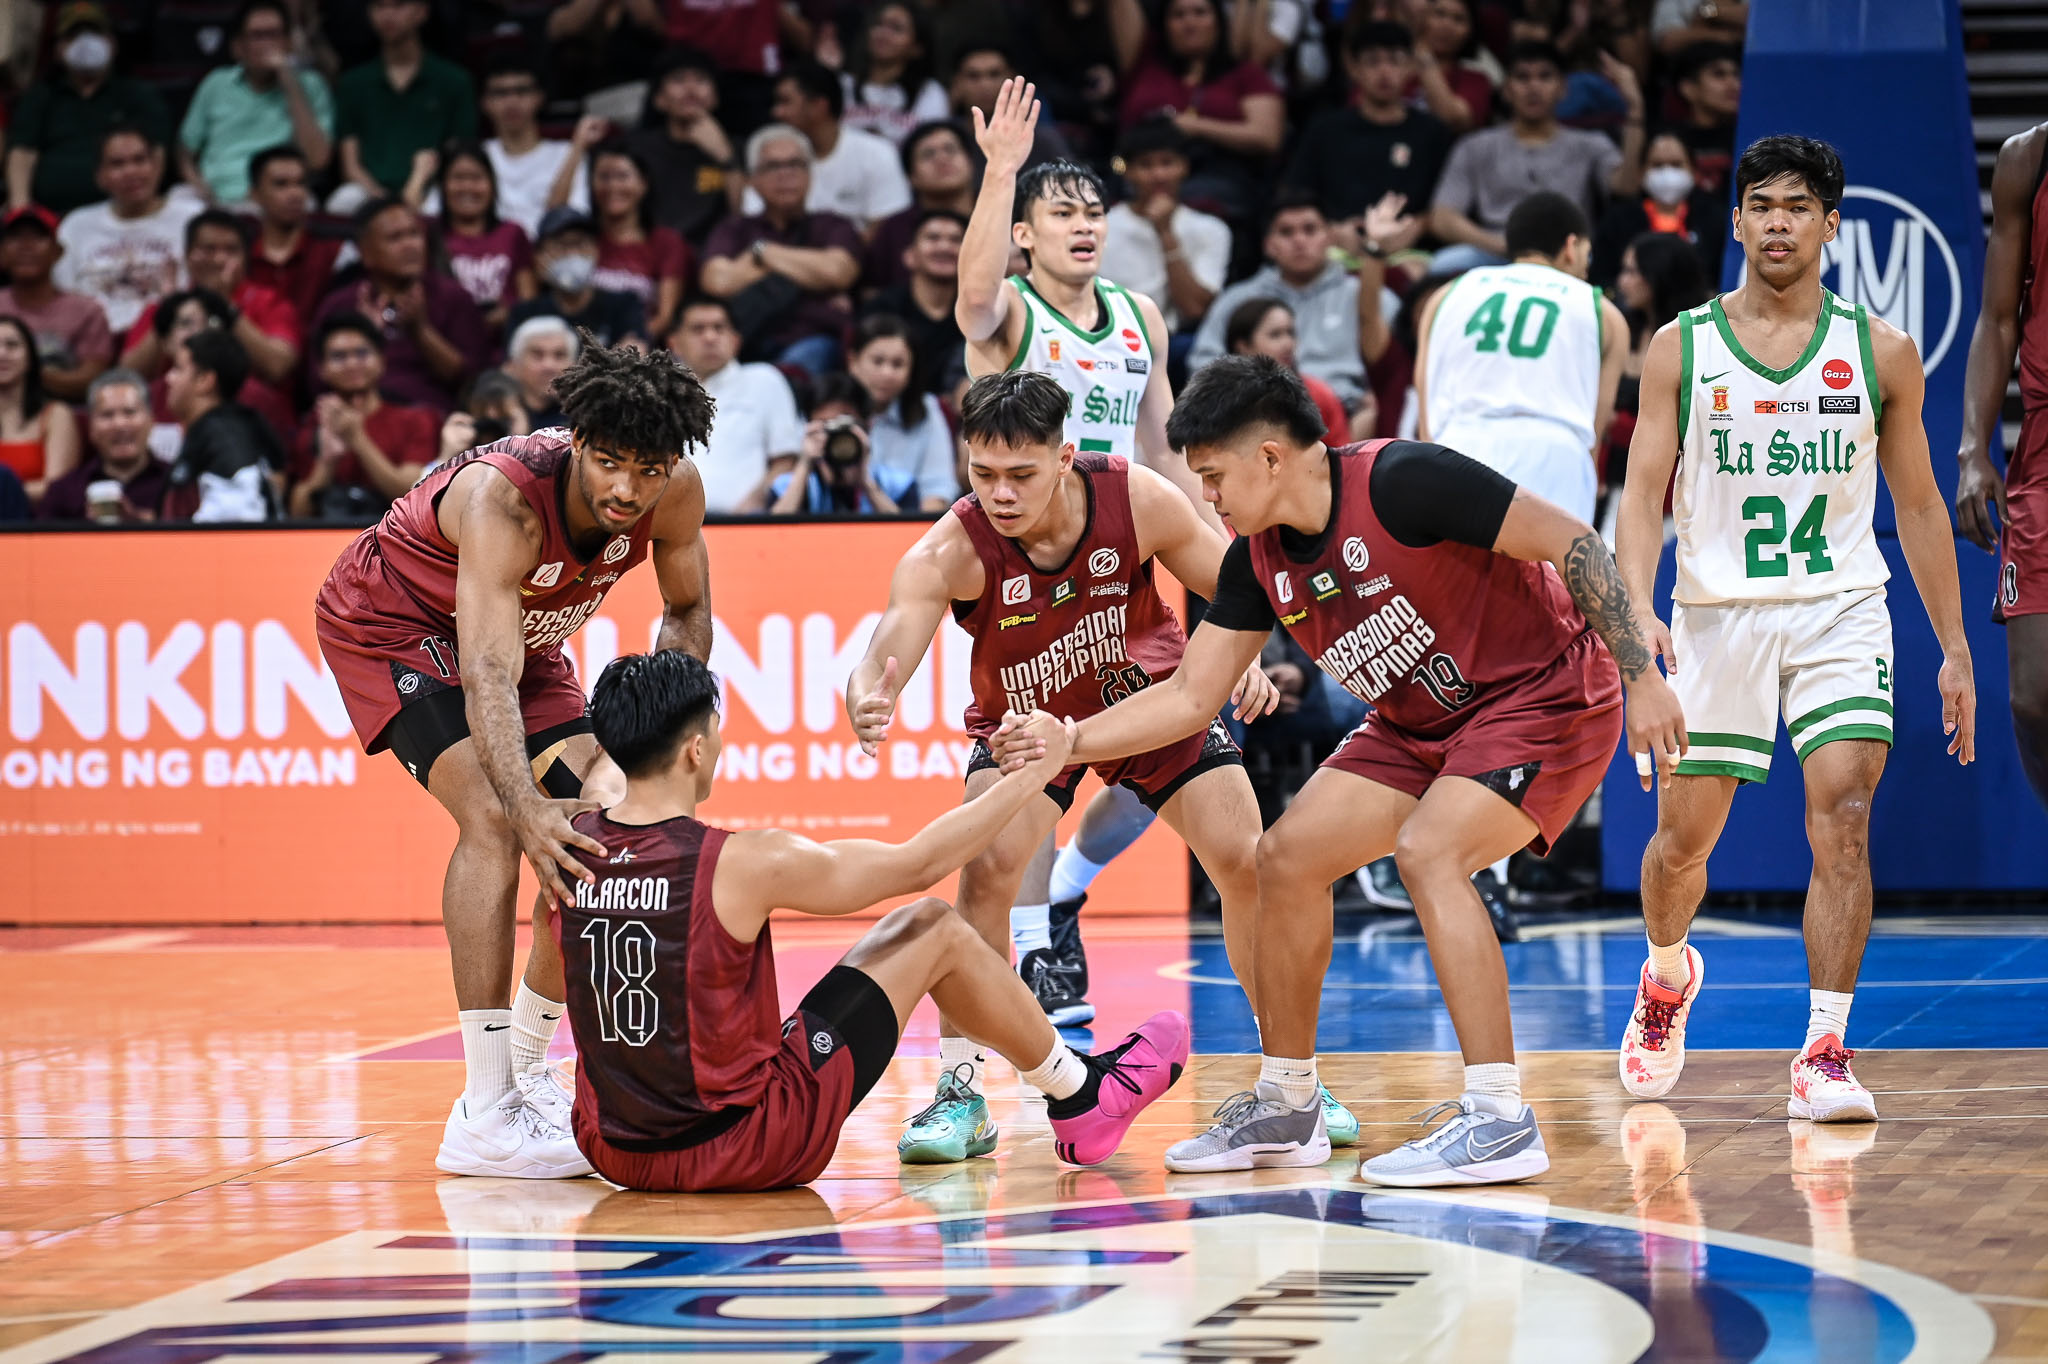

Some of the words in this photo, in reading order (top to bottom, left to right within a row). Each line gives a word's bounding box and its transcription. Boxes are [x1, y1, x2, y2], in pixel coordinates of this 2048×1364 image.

[1464, 291, 1561, 359] 40
[1823, 369, 1851, 380] Gazz
[1082, 384, 1138, 426] Sall
[1777, 401, 1809, 413] ICTSI
[1826, 399, 1854, 407] CWC
[1709, 428, 1755, 476] La
[1766, 428, 1857, 477] Salle
[1741, 494, 1834, 579] 24
[1314, 594, 1417, 683] NIBERSIDAD
[0, 619, 354, 742] NKIN
[1042, 633, 1129, 704] PILIPINA
[1411, 652, 1476, 713] 19
[1876, 656, 1893, 693] 2
[0, 749, 110, 789] ONG
[121, 749, 193, 788] NG
[202, 748, 357, 788] BAYAN
[807, 742, 878, 780] NG
[890, 740, 972, 779] BAY
[575, 877, 670, 911] ALARCON
[580, 917, 660, 1047] 18
